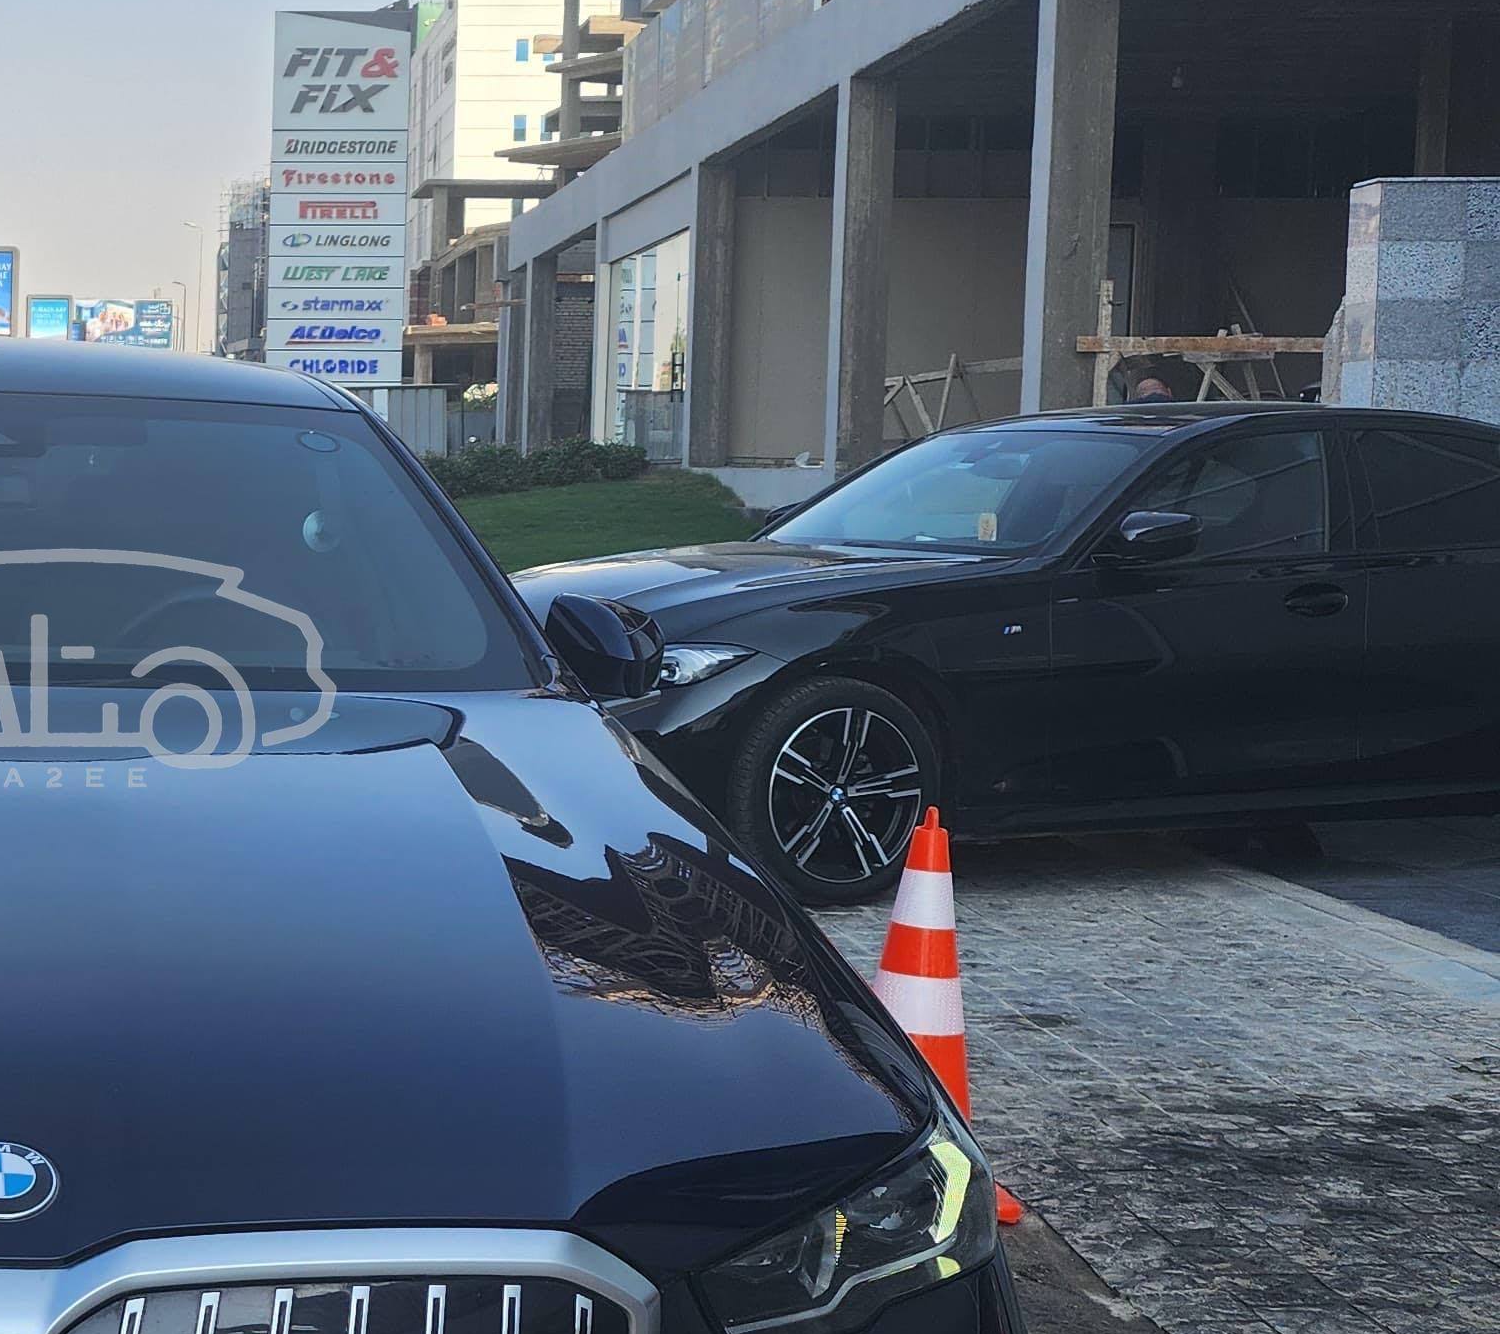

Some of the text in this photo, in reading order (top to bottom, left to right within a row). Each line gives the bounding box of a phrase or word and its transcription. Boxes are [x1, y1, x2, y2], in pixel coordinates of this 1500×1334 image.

[284, 138, 398, 155] BRIDGESTONE
[282, 169, 395, 187] Firestone
[299, 201, 378, 220] PIRELLI
[315, 234, 391, 247] LINGLONG
[283, 266, 390, 281] WEST LAKE
[302, 296, 383, 312] starmaxx
[289, 325, 381, 340] ACDelco
[289, 359, 379, 375] CHLORIDE
